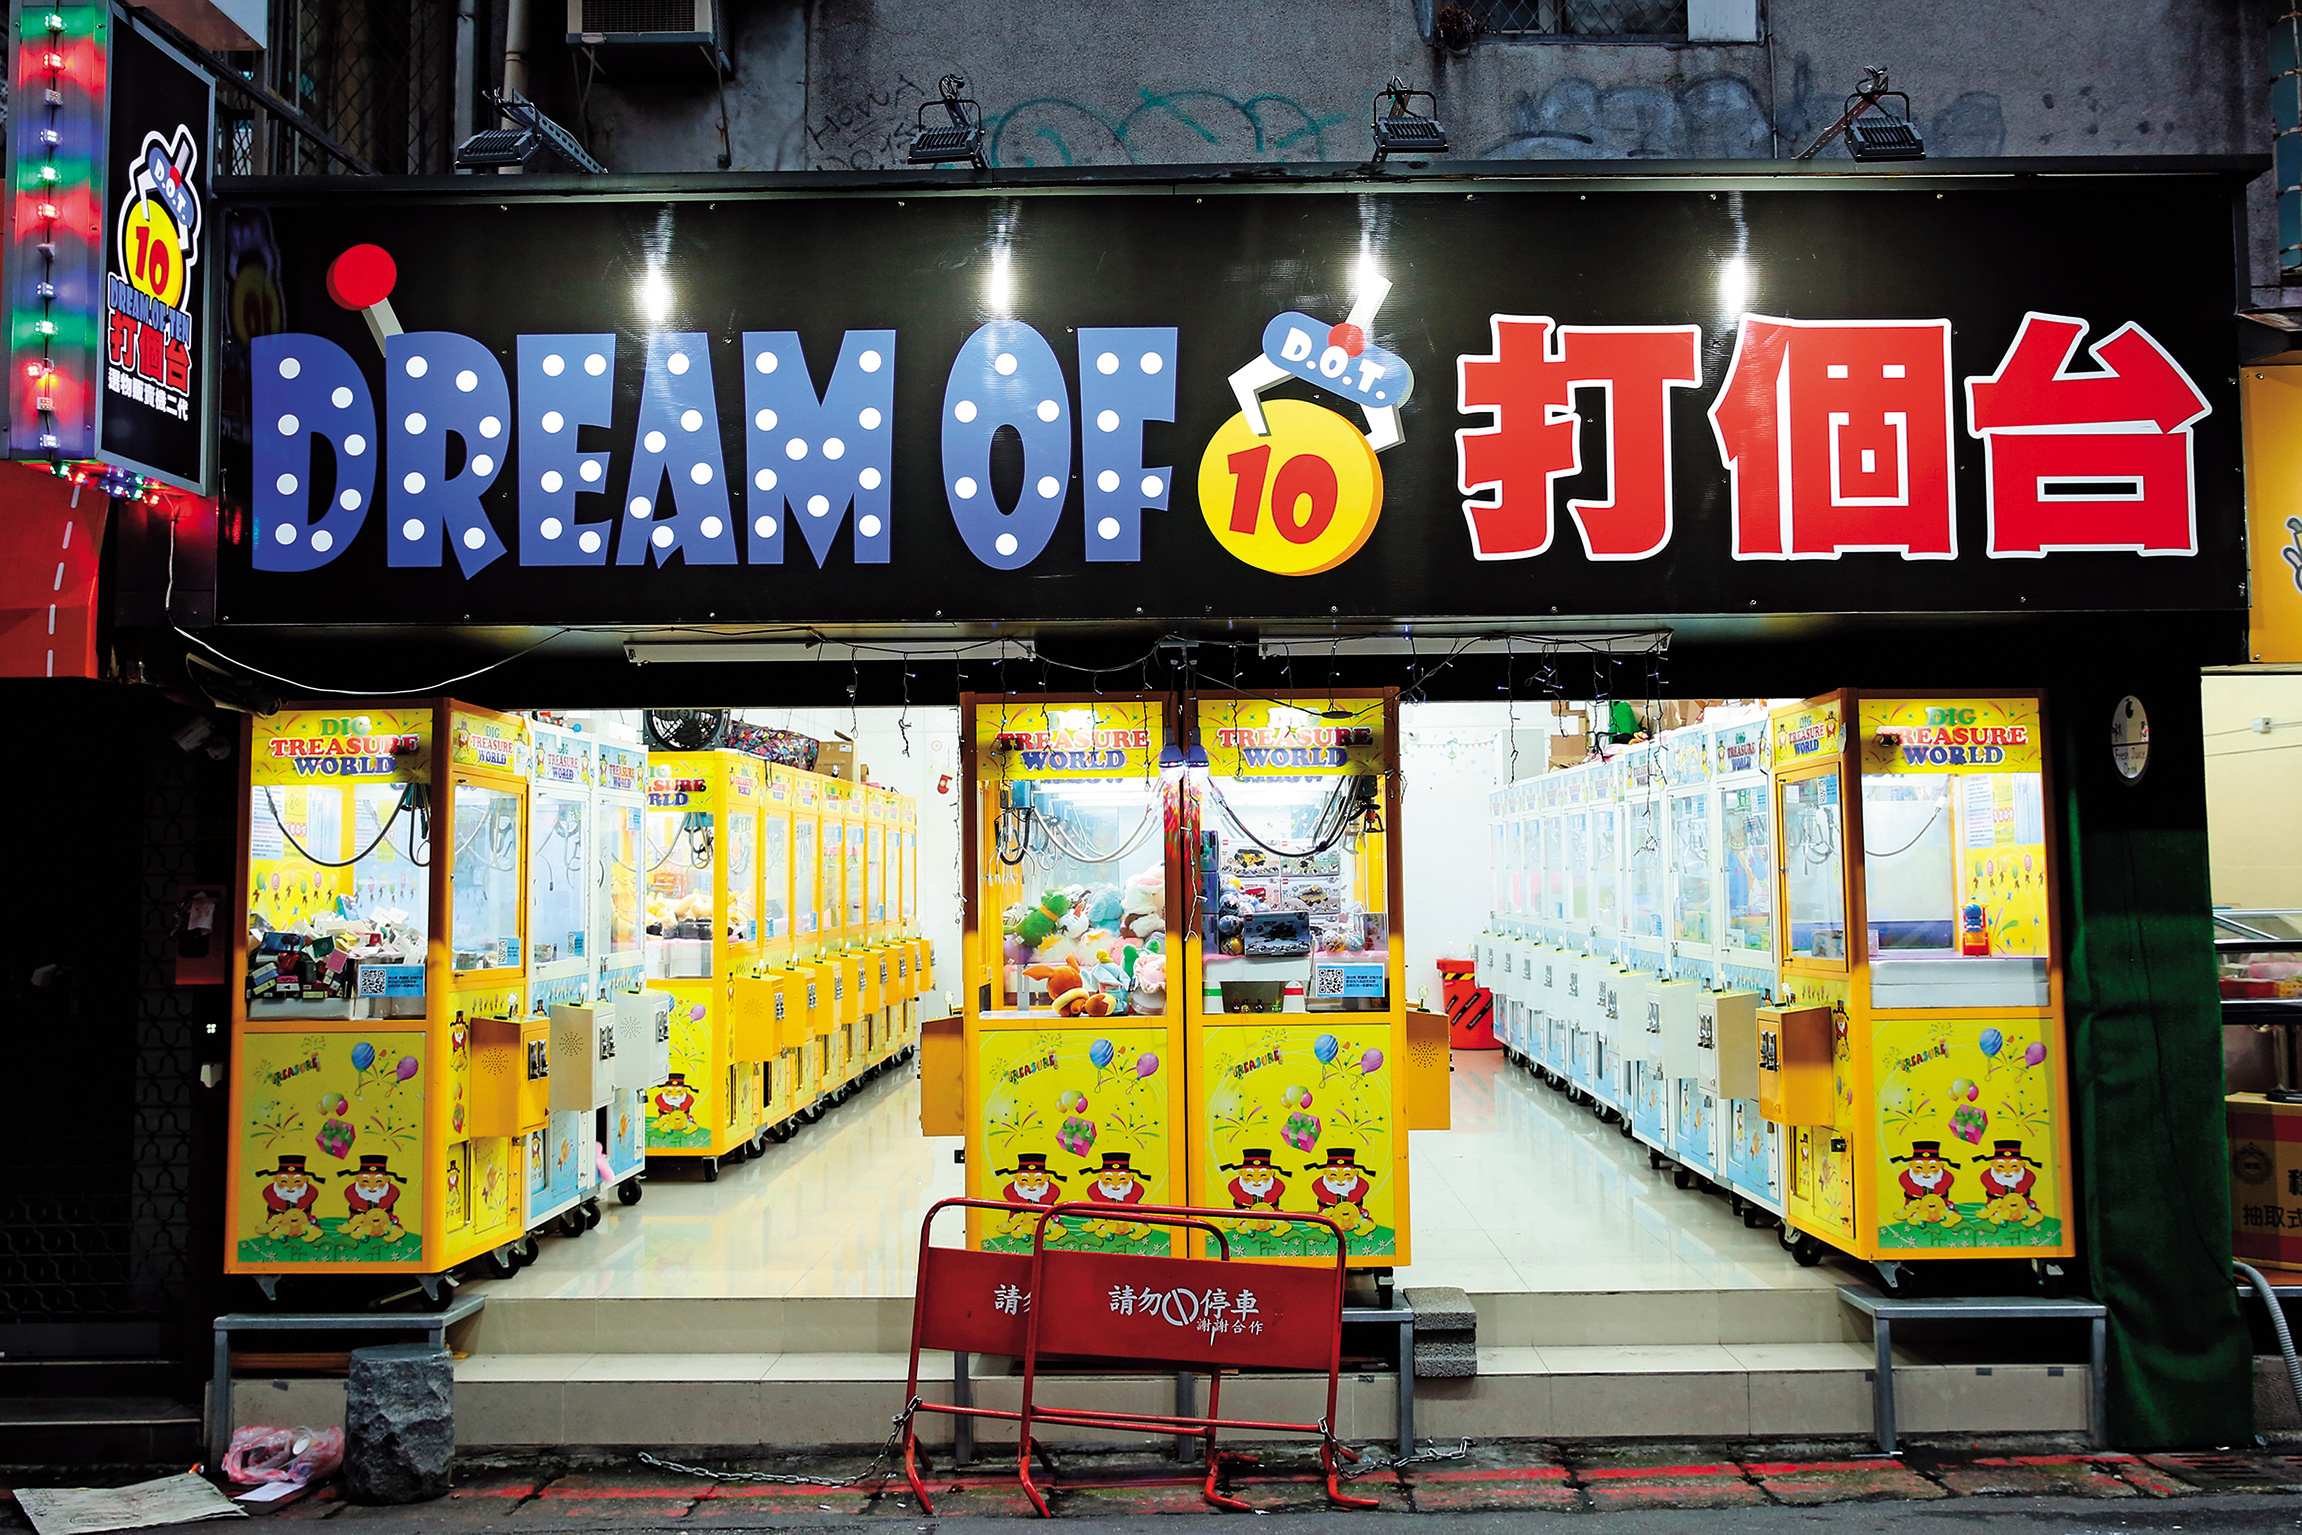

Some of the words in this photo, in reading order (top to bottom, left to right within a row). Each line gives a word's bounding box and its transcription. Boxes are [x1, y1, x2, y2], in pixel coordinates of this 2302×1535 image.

[154, 158, 186, 220] D.O.T.
[135, 226, 170, 295] 10
[109, 276, 150, 326] DREAM
[151, 297, 167, 332] OF
[168, 305, 190, 346] TEN
[109, 308, 191, 395] 打個台
[1279, 326, 1387, 400] D.O.T.
[108, 366, 188, 421] 選物販賣機二代
[1456, 311, 2212, 560] 打個台
[251, 330, 896, 580] DREAM
[942, 320, 1178, 571] OF
[1227, 444, 1338, 544] 10
[1799, 715, 1812, 728] DIG
[1925, 706, 1976, 726] DIG
[320, 716, 372, 737] DIG
[485, 725, 500, 738] DIG
[1788, 724, 1825, 744] TREASURE
[1877, 725, 2028, 746] TREASURE
[270, 734, 419, 757] TREASURE
[471, 735, 513, 753] TREASURE
[996, 729, 1150, 750] TREASURE
[1217, 727, 1373, 747] TREASURE
[1794, 739, 1819, 755] WORLD
[478, 750, 507, 765] WORLD
[548, 754, 578, 768] TREASURE
[1021, 751, 1127, 771] WORLD
[1242, 747, 1349, 767] WORLD
[1902, 746, 2005, 766] WORLD
[293, 756, 396, 777] WORLD
[609, 764, 635, 778] TREASURE
[648, 764, 672, 778] IG
[648, 778, 707, 792] SURE
[648, 793, 689, 807] RLD
[1108, 1284, 1163, 1316] 請勿
[1200, 1287, 1260, 1321] 停車
[1196, 1318, 1264, 1336] 謝謝合作
